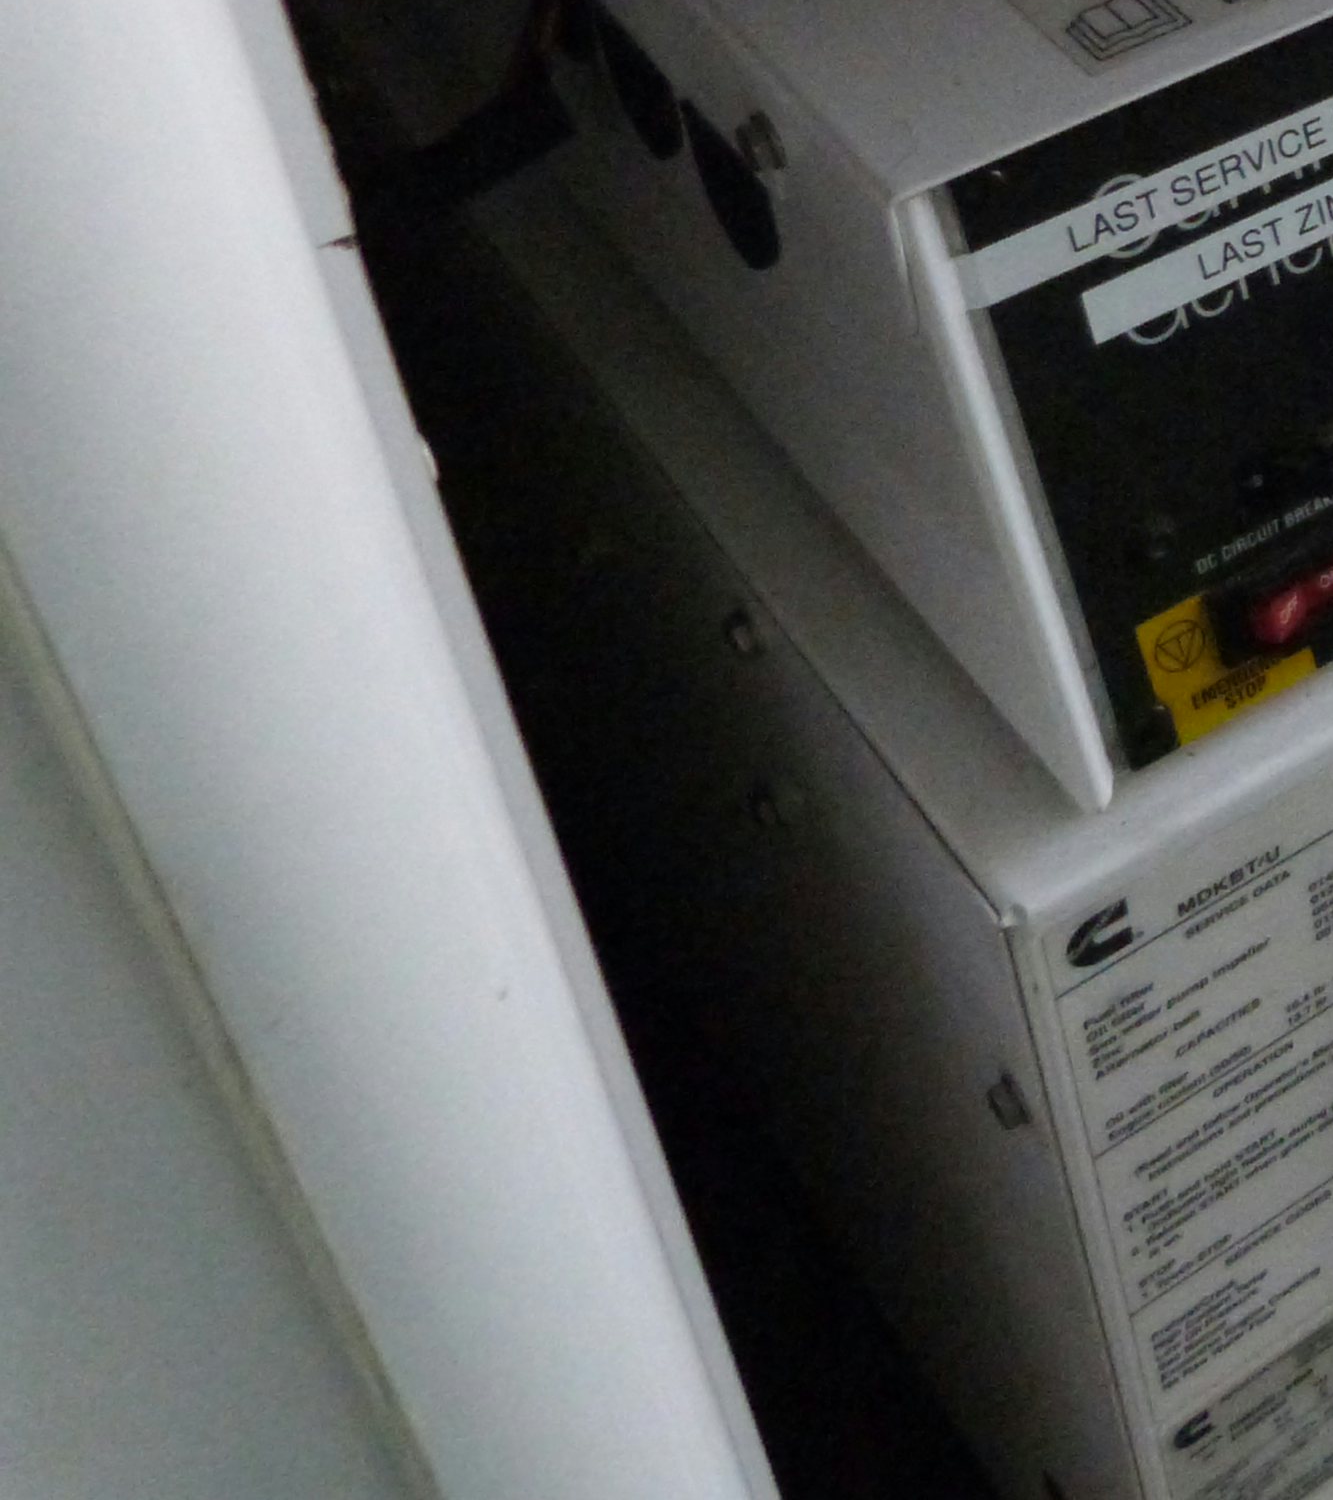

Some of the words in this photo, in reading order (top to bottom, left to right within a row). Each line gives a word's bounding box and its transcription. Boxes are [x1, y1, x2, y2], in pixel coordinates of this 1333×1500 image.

[1066, 185, 1164, 253] LAST
[1167, 115, 1328, 210] SERVICE
[1196, 216, 1288, 280] LAST
[1195, 550, 1219, 574] DC
[1220, 517, 1280, 561] CIRCUIT
[1222, 672, 1270, 712] STOP
[1212, 1038, 1294, 1100] OPERATION
